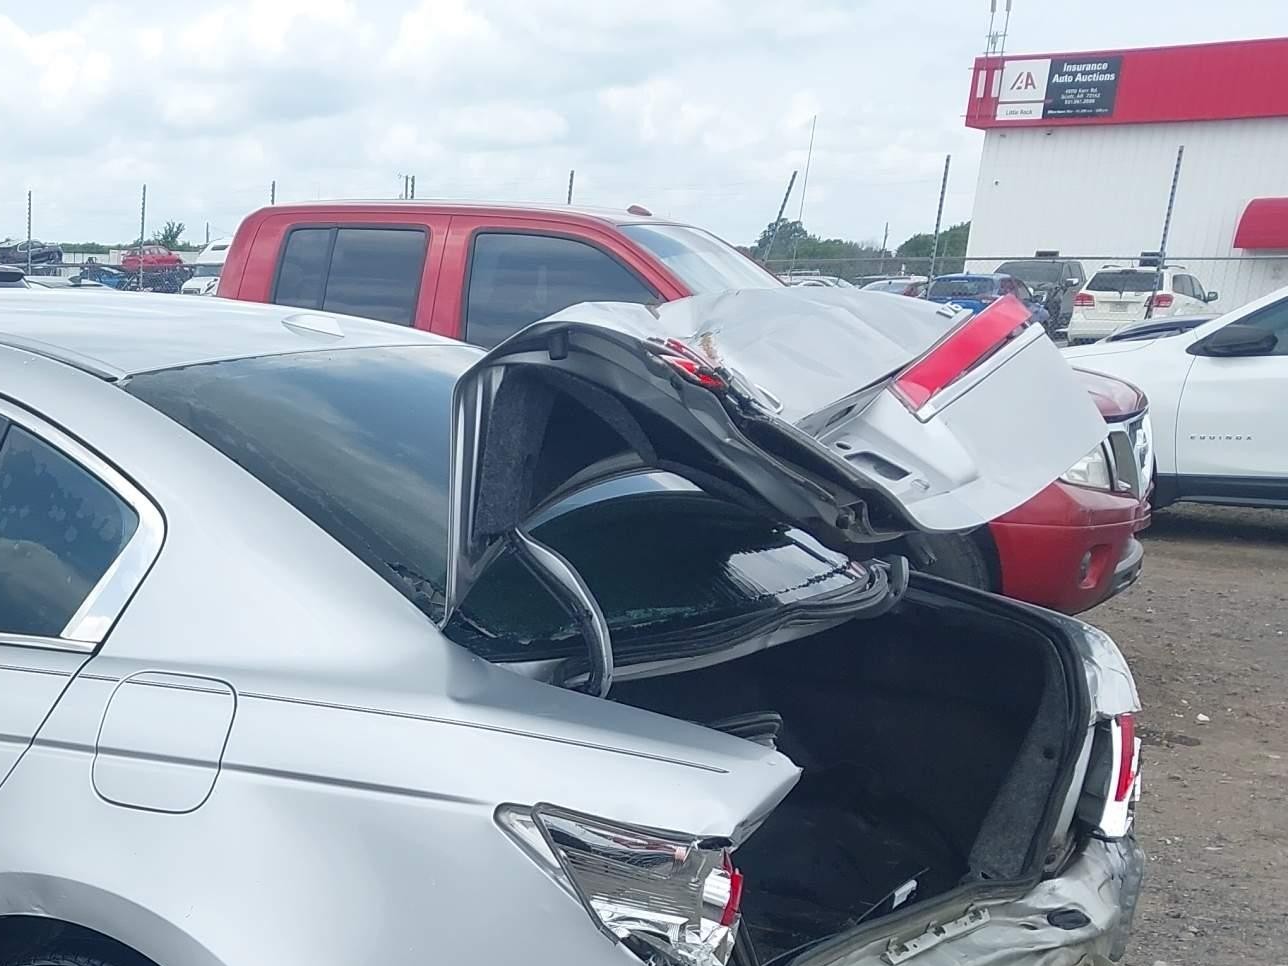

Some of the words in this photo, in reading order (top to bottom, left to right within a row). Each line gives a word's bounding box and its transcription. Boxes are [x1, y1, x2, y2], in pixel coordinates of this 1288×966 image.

[1063, 62, 1108, 72] Insurance
[1052, 73, 1074, 84] Auto
[1074, 72, 1116, 83] Auctions
[936, 301, 963, 319] V6
